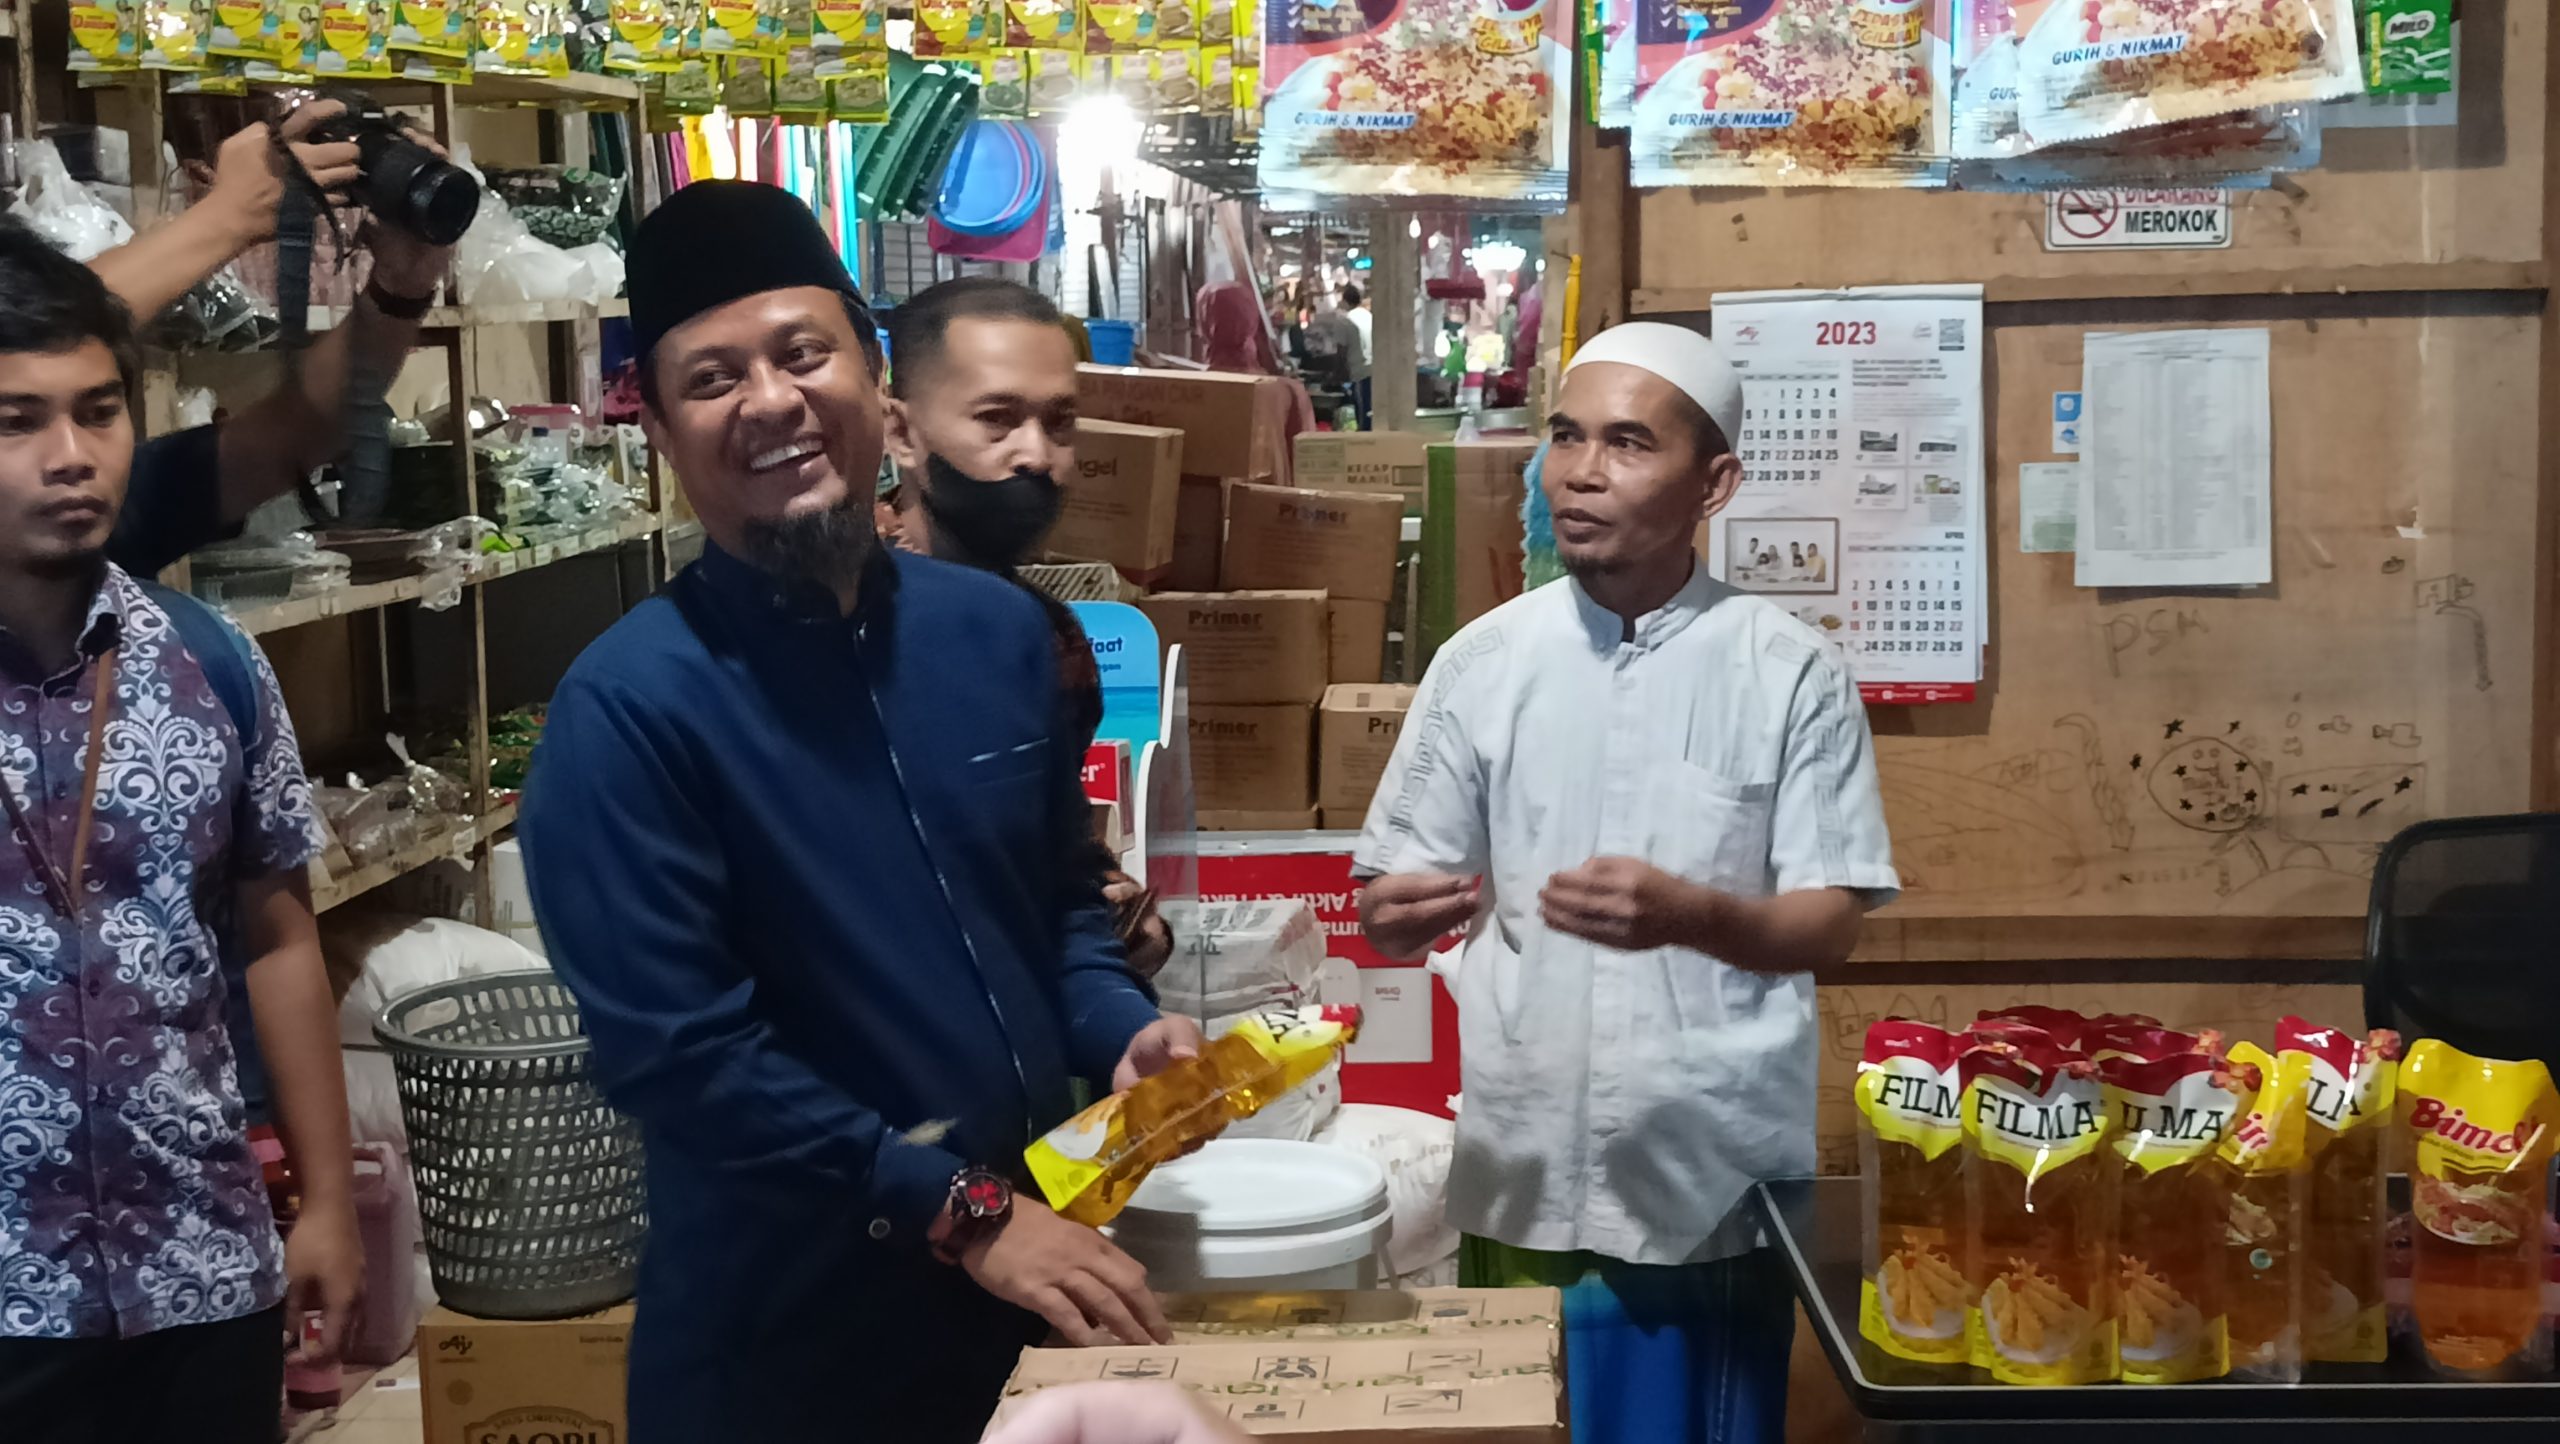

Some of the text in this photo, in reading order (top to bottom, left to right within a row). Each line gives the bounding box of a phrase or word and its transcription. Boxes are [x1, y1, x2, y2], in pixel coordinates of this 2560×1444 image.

[2390, 19, 2430, 35] MILO
[2052, 47, 2100, 66] GURIH
[2120, 35, 2184, 55] NIKMAT
[1356, 115, 1414, 127] NIKMAT
[1669, 113, 1716, 126] GURIH
[1732, 112, 1793, 126] NIKMAT
[2124, 209, 2218, 234] MEROKOK
[1816, 321, 1876, 346] 2023
[1780, 387, 1837, 399] 1 2 3 4
[1810, 408, 1821, 419] 10
[1759, 430, 1771, 440] 14
[1777, 430, 1788, 440] 15
[1811, 429, 1821, 440] 17
[1742, 450, 1755, 461] 20
[1760, 450, 1771, 461] 21
[1791, 450, 1805, 461] 23
[1808, 449, 1821, 460] 24
[1825, 449, 1839, 461] 25
[1347, 463, 1389, 473] KECAP
[1347, 474, 1390, 484] MANIS
[1852, 580, 1859, 591] 2
[1869, 580, 1876, 591] 3
[1885, 580, 1893, 590] 4
[1902, 580, 1909, 590] 5
[1866, 600, 1878, 611] 10
[1900, 600, 1911, 611] 12
[1934, 600, 1945, 611] 14
[1951, 600, 1962, 611] 15
[1187, 610, 1263, 625] Primer
[1867, 620, 1876, 631] 17
[1915, 620, 1929, 632] 20
[1934, 620, 1945, 632] 21
[1864, 640, 1878, 652] 24
[1881, 640, 1895, 652] 25
[1898, 640, 1912, 652] 26
[1916, 640, 1928, 652] 27
[1188, 717, 1258, 735] Primer
[1976, 1088, 2099, 1141] FILMA
